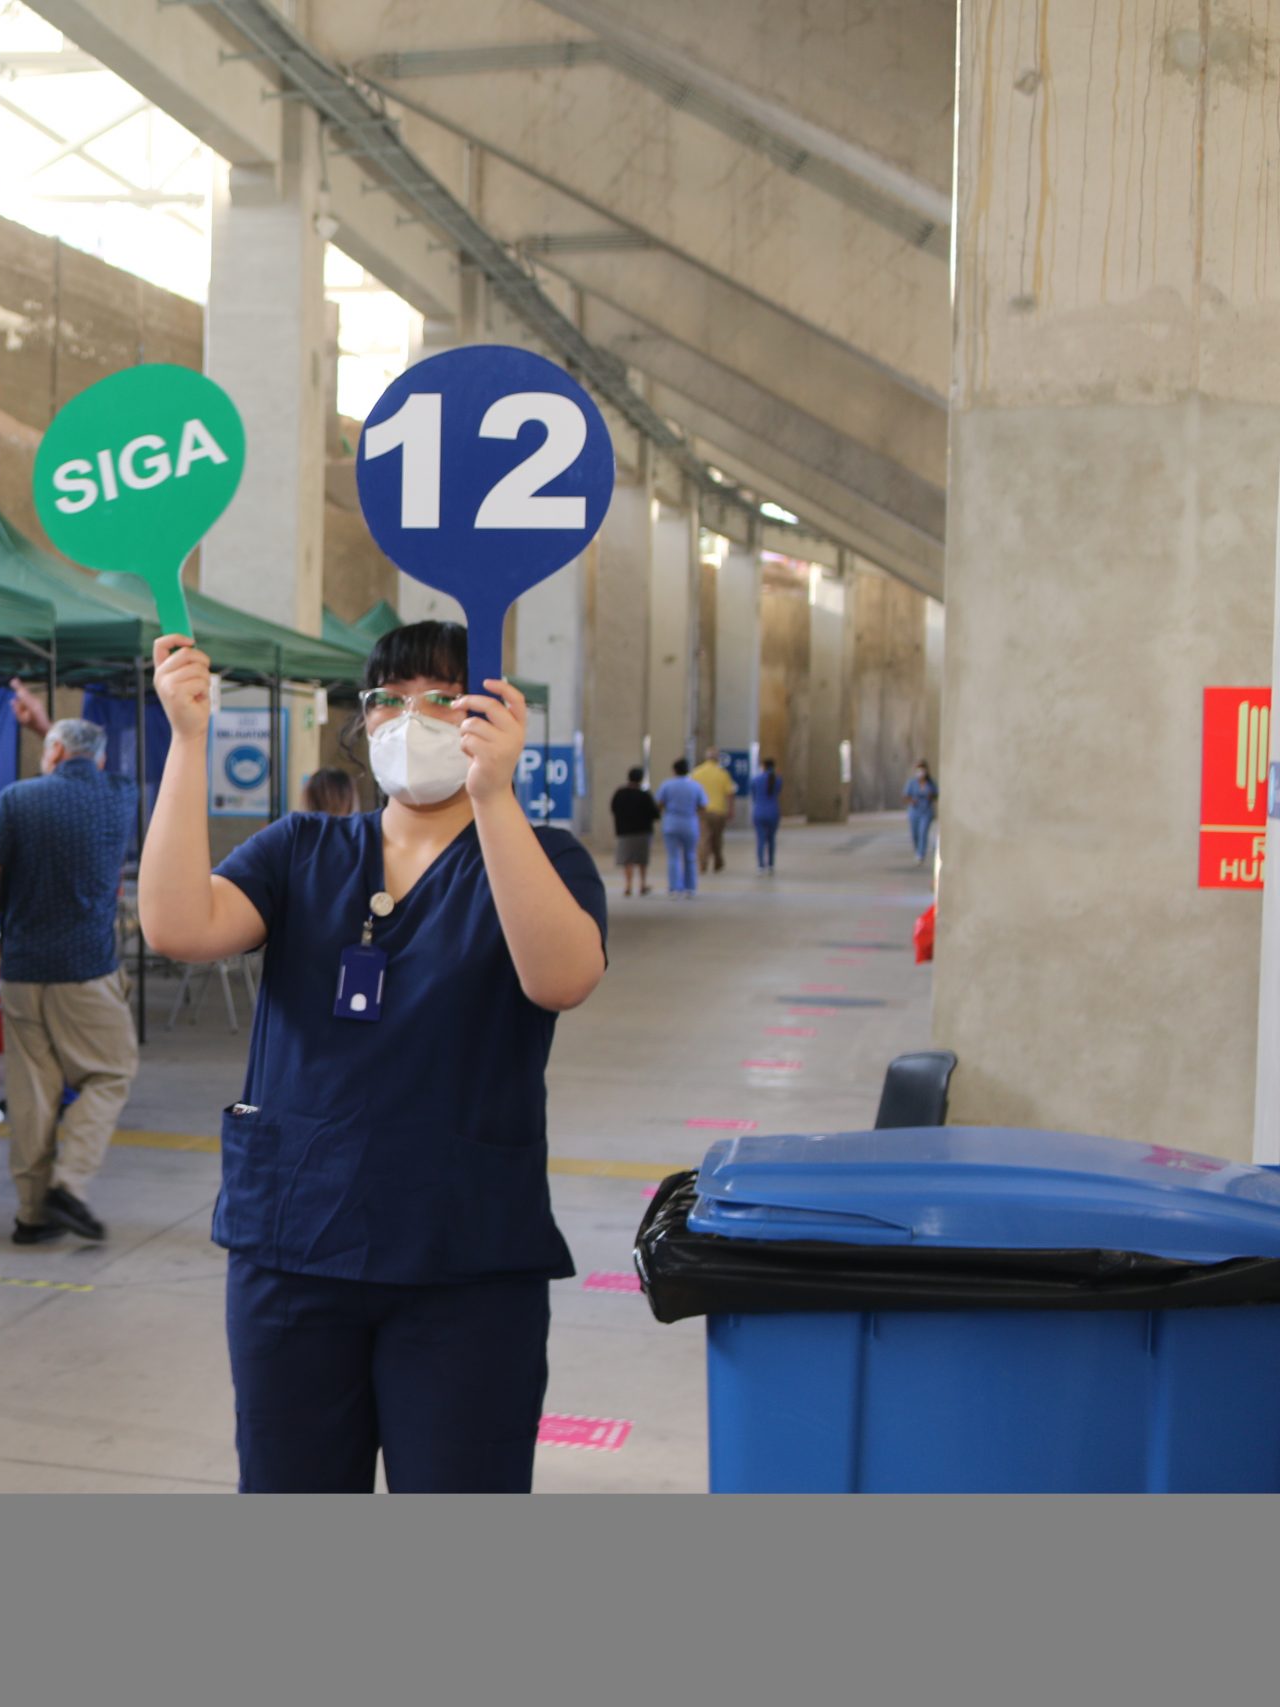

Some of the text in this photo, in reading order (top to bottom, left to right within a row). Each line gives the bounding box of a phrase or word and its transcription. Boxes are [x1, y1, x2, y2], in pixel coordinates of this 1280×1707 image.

[52, 418, 229, 515] SIGA
[364, 391, 587, 529] 12
[1220, 858, 1265, 882] HU
